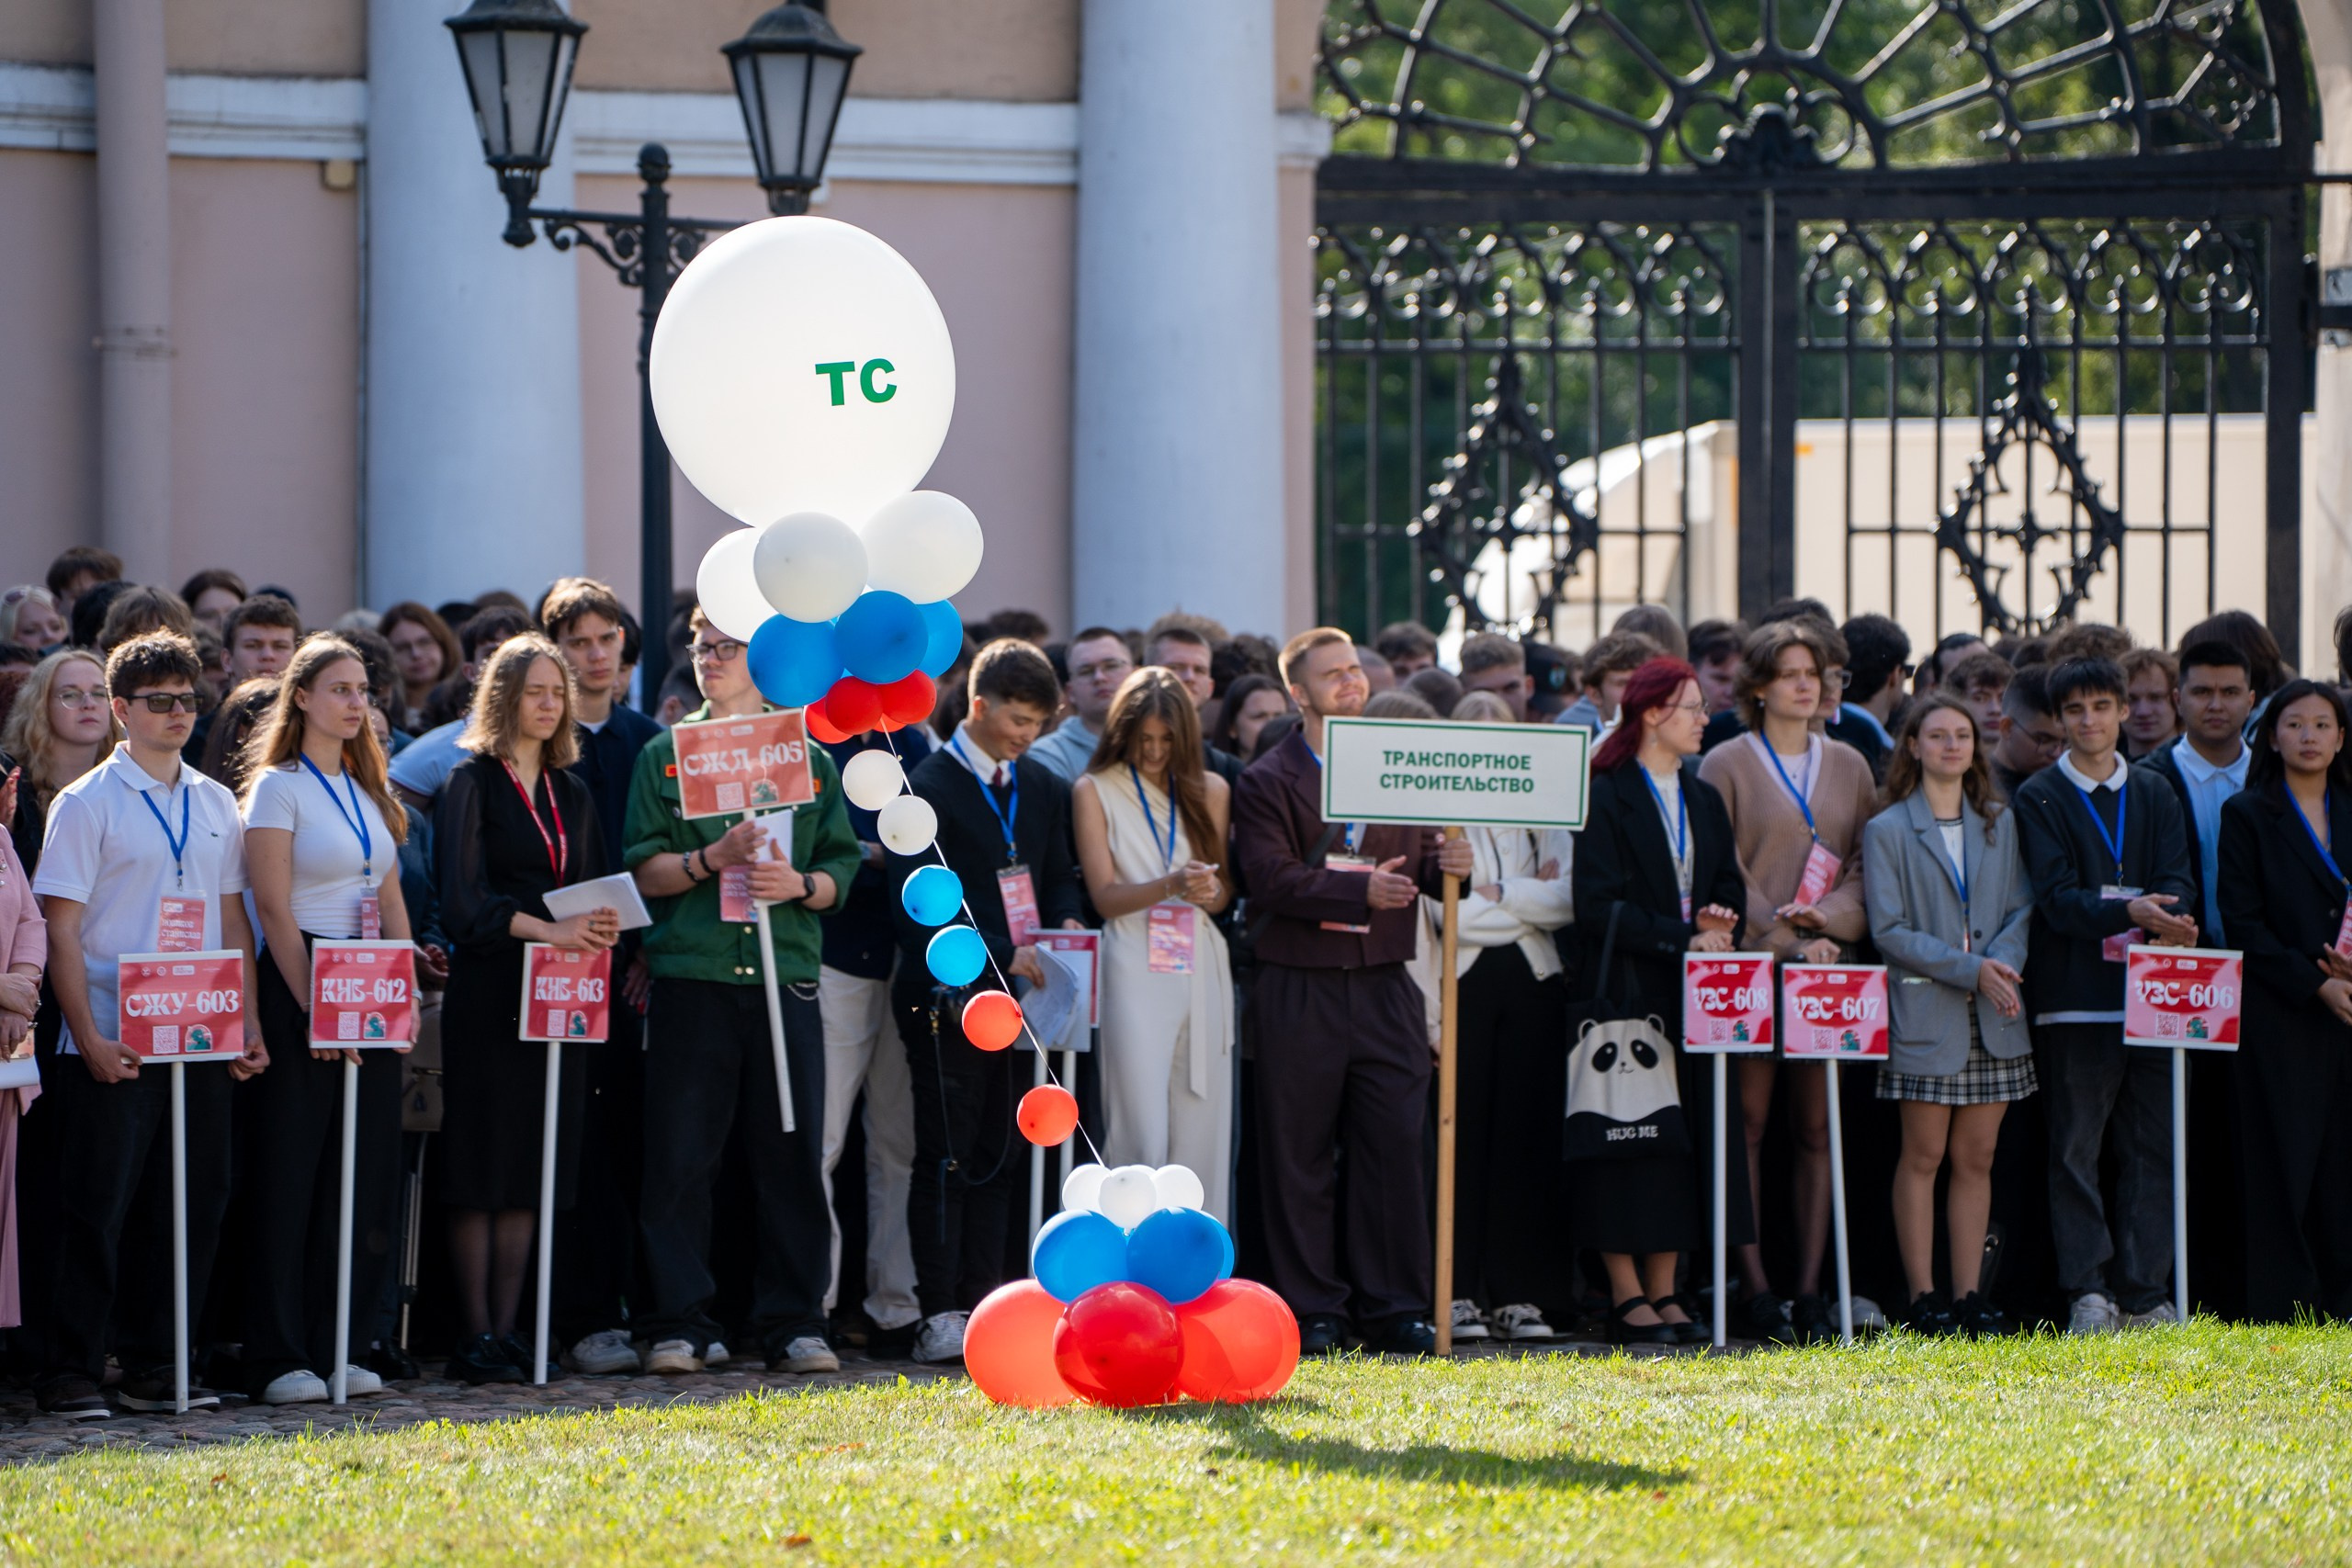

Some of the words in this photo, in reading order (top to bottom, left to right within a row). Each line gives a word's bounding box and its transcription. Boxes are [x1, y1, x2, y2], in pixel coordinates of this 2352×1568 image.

[815, 358, 898, 406] ТС
[1383, 750, 1532, 771] ТРАНСПОРТНОЕ
[1380, 773, 1535, 794] СТРОИТЕЛЬСТВО
[321, 977, 407, 1003] КНБ-612
[535, 976, 605, 1002] КНБ-613
[1692, 986, 1768, 1011] УЗС-608
[2134, 979, 2234, 1010] УЗС-606
[125, 989, 239, 1017] СЖУ-603
[1792, 996, 1882, 1021] УЗС-607
[1606, 1126, 1636, 1141] HUG
[1638, 1125, 1658, 1139] ME
